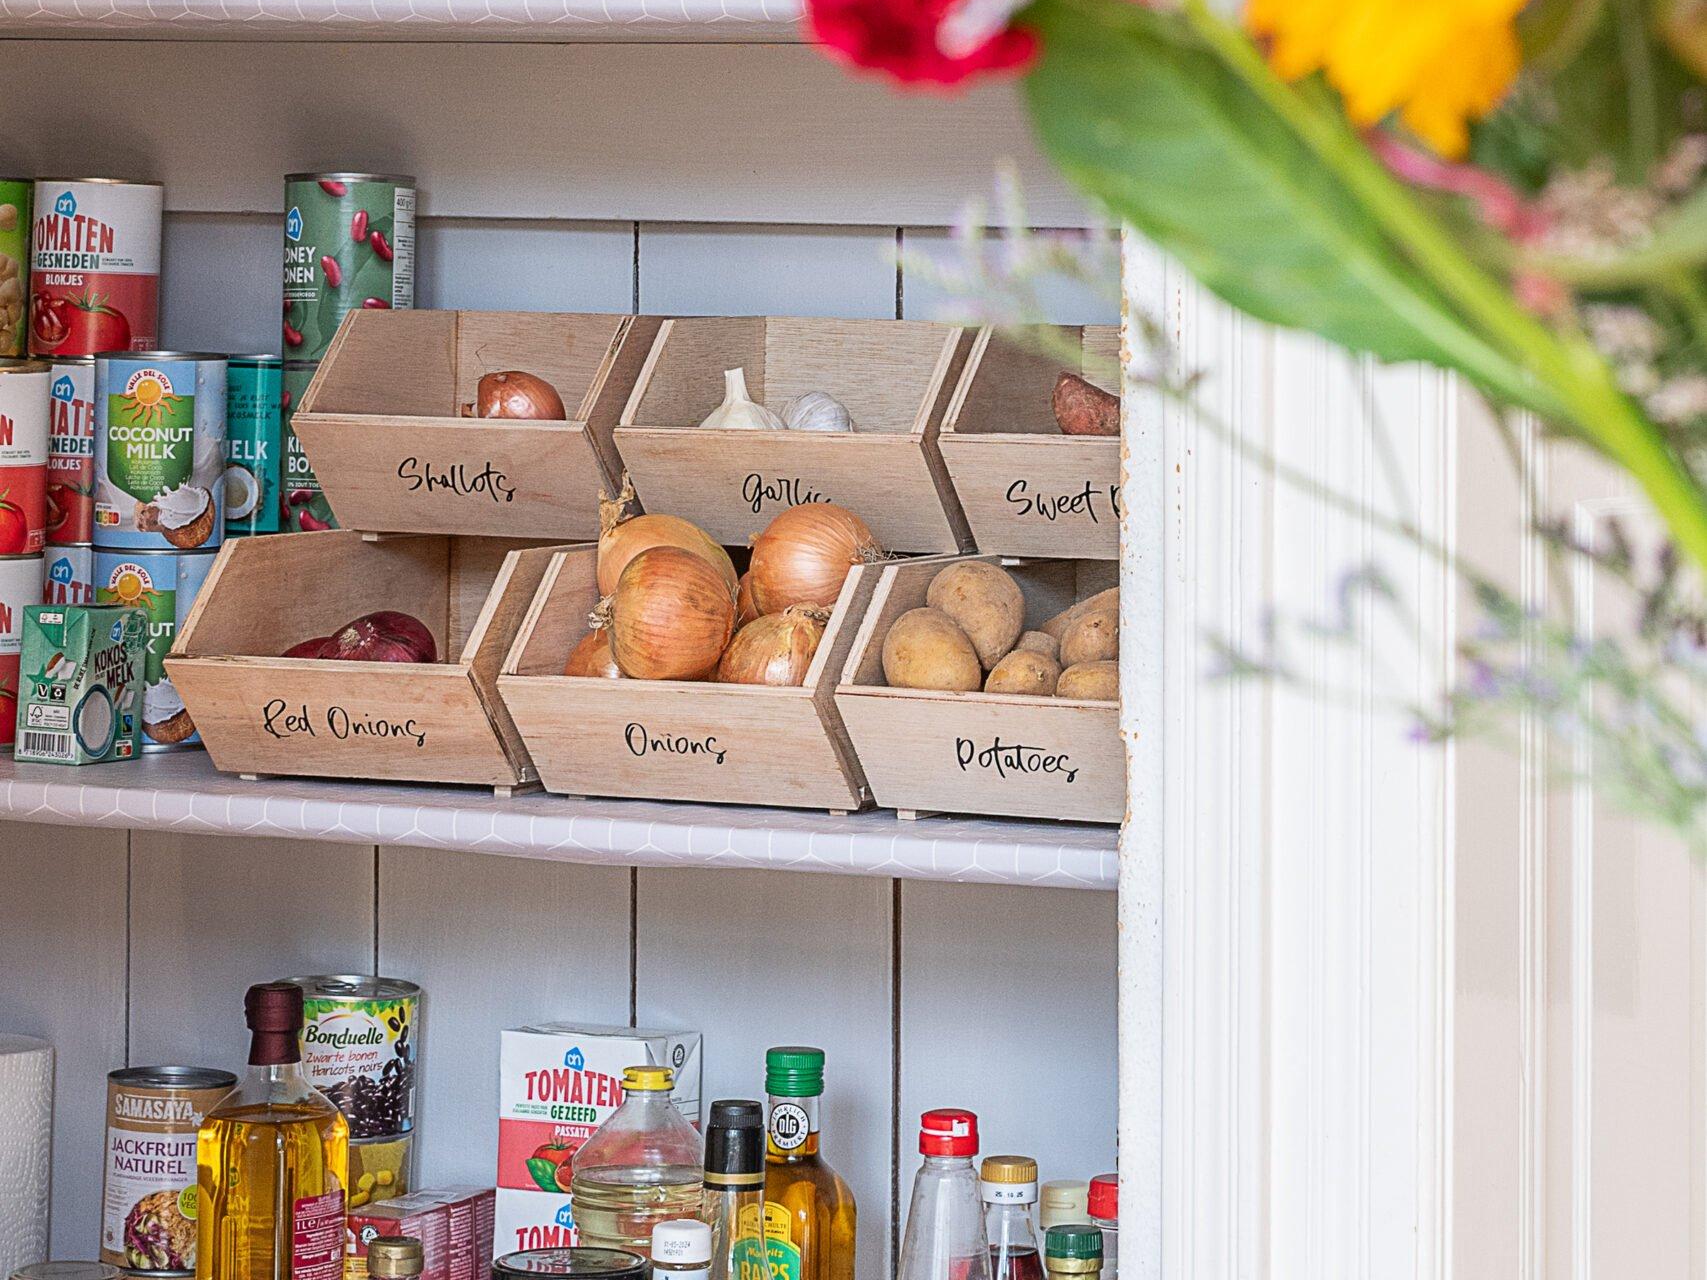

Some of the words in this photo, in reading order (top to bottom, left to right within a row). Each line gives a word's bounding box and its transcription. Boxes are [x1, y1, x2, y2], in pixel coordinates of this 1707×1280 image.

[37, 253, 100, 269] GESNEDEN
[45, 273, 84, 286] BLOKJES
[128, 372, 143, 390] VALLE
[157, 374, 171, 390] SOLE
[109, 426, 193, 442] COCONUT
[126, 444, 176, 459] MILK
[397, 456, 516, 502] Shallots
[1006, 479, 1102, 524] Sweet
[111, 566, 122, 584] VALLE
[137, 569, 149, 584] SOLE
[94, 641, 128, 674] KOKOS
[106, 661, 135, 689] MELK
[263, 699, 315, 739] Red
[327, 706, 426, 748] Onions
[624, 722, 727, 764] Onions
[956, 736, 1079, 783] Potatoes
[305, 1024, 384, 1049] Bonduelle
[306, 1052, 345, 1063] Zwarte
[348, 1051, 378, 1061] bonen
[312, 1064, 355, 1077] Haricots
[358, 1061, 384, 1073] noirs
[524, 1069, 626, 1107] TOMATEN
[115, 1094, 193, 1120] SAMASAYA
[550, 1105, 597, 1122] GEZEEFD
[554, 1125, 590, 1139] PASSATA
[111, 1137, 196, 1157] JACKFRUIT
[114, 1156, 187, 1174] NATUREL
